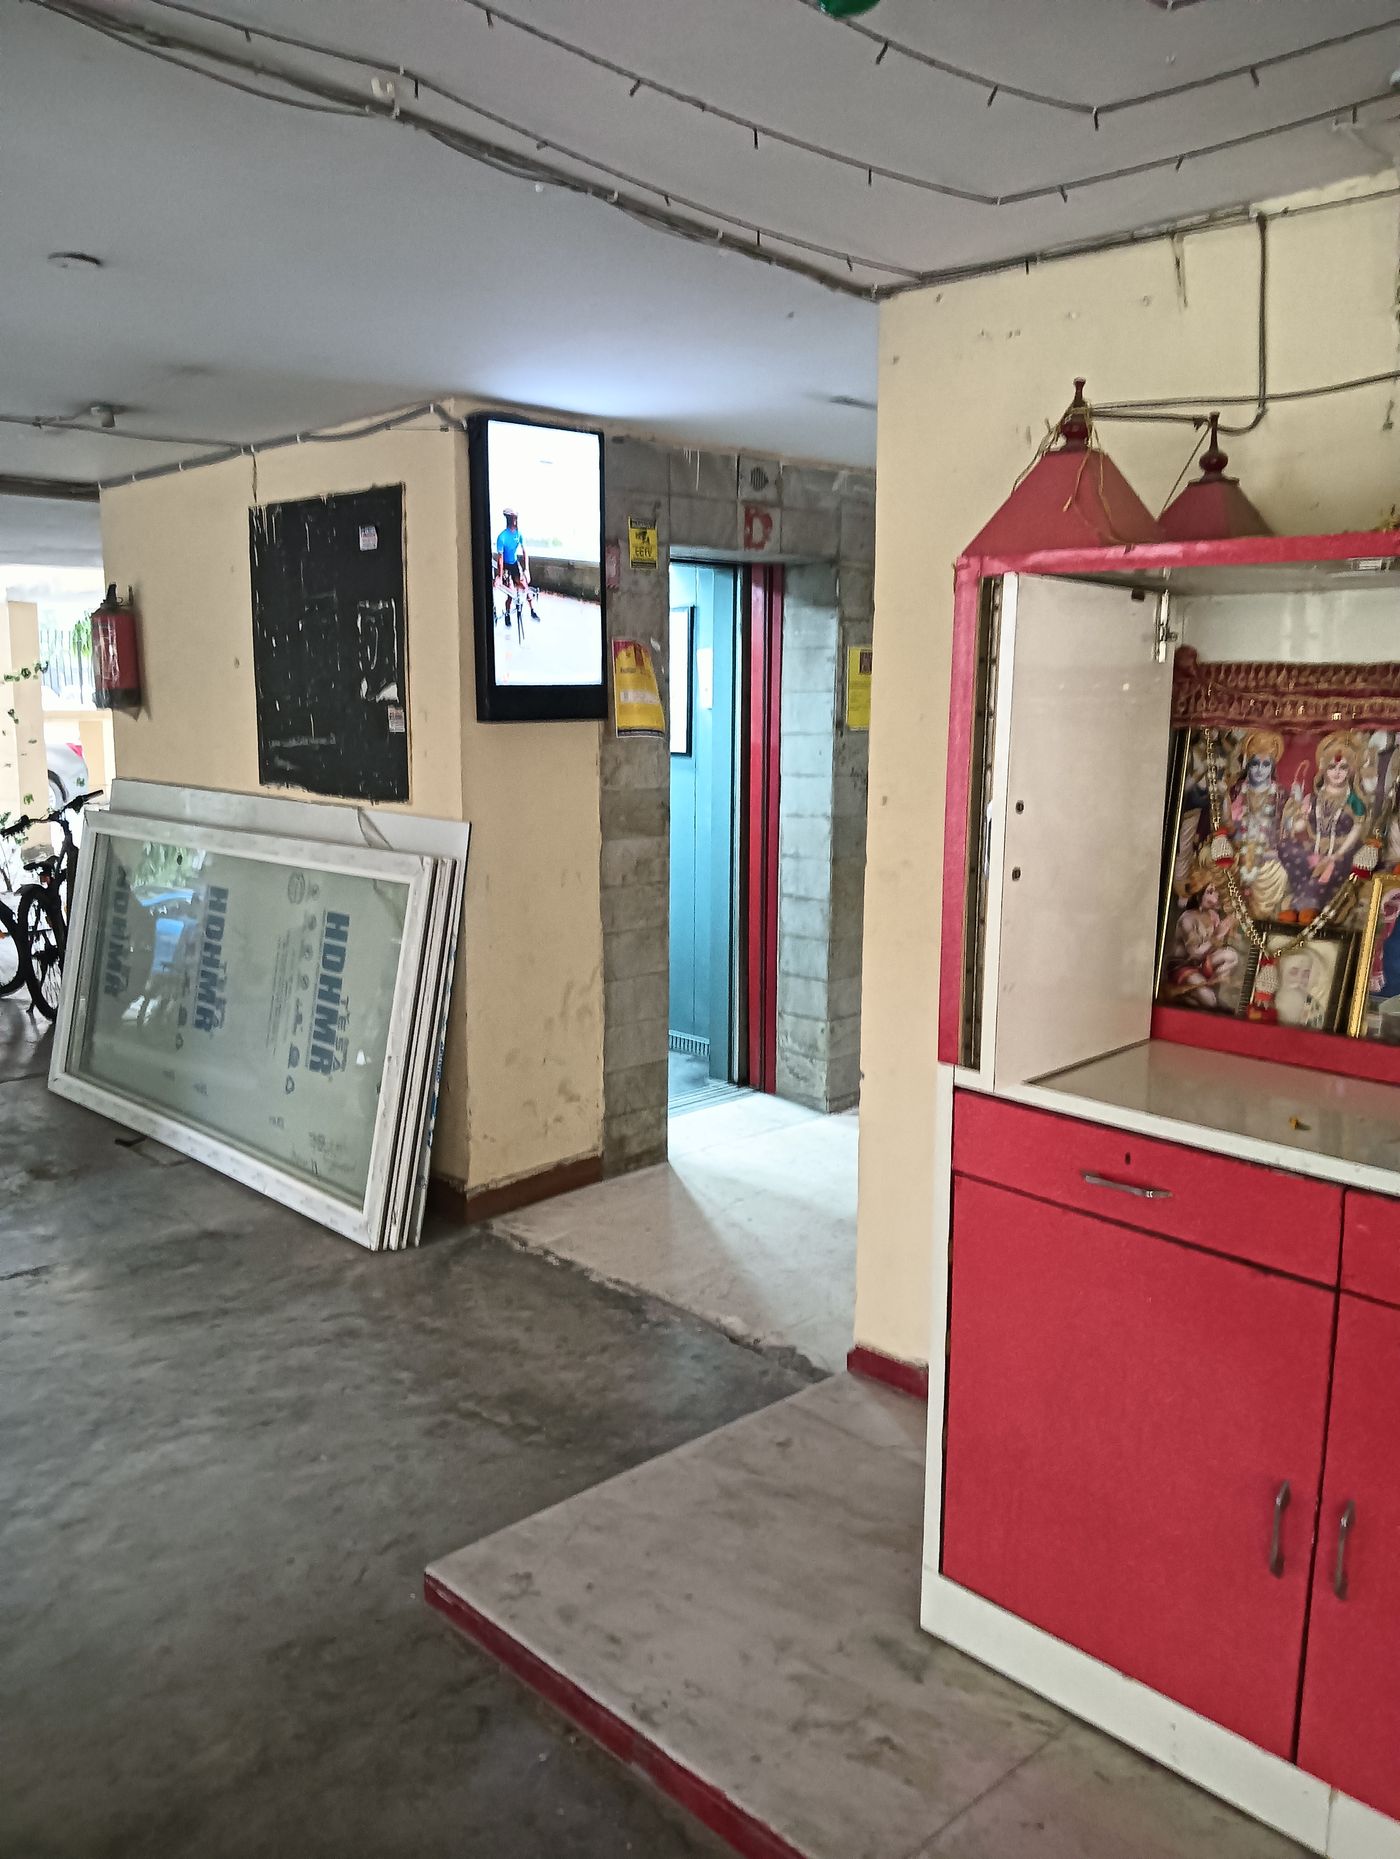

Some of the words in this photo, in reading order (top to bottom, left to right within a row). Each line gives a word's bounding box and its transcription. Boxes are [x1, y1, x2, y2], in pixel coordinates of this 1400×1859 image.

[744, 504, 773, 550] D
[194, 886, 229, 1032] HDHMR
[309, 911, 350, 1075] HDHMR
